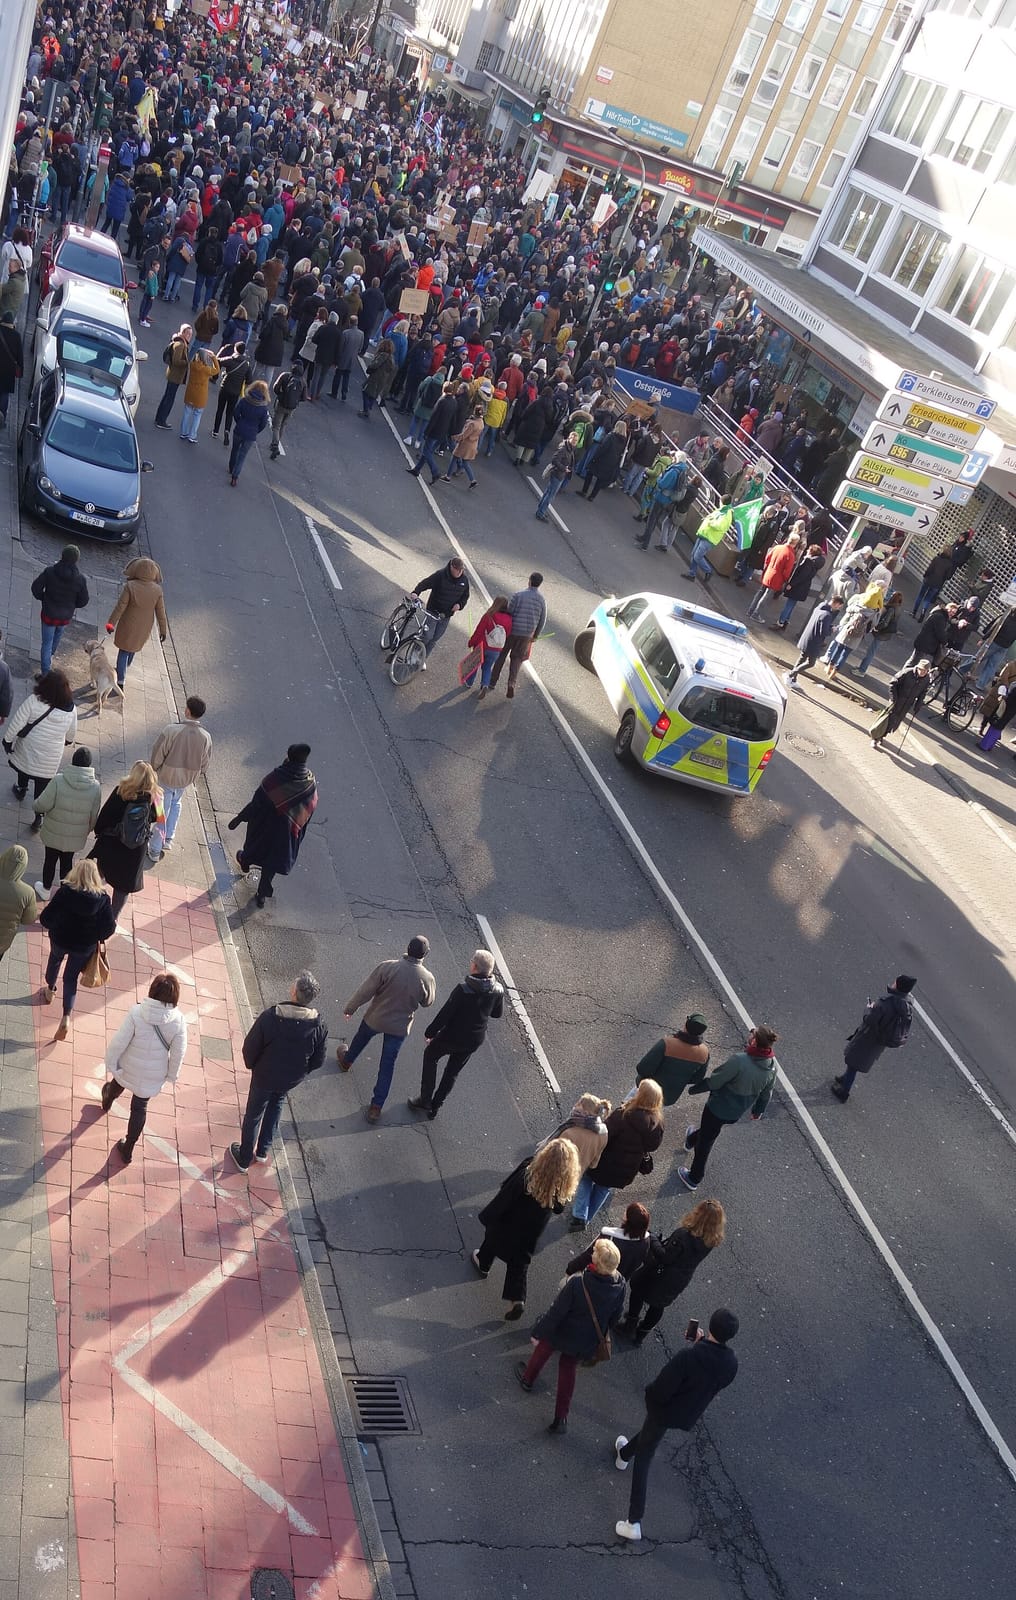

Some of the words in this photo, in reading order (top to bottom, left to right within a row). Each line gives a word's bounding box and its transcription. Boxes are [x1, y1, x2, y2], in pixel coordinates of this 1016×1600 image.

[634, 379, 672, 397] Oststraße
[916, 383, 976, 409] Parkleitsystem
[911, 404, 968, 430] Friedrichstadt
[896, 436, 908, 445] Ko
[930, 427, 946, 438] freie
[949, 432, 968, 445] Plätze
[863, 460, 895, 476] Altstadt
[890, 446, 909, 459] 896
[915, 457, 931, 468] freie
[933, 461, 953, 475] Plätze
[848, 489, 859, 498] Ko
[858, 469, 881, 484] 1220
[882, 481, 898, 491] freie
[900, 486, 920, 498] Plätze
[842, 498, 862, 511] 859
[867, 510, 883, 520] freie
[885, 514, 905, 527] Plätze
